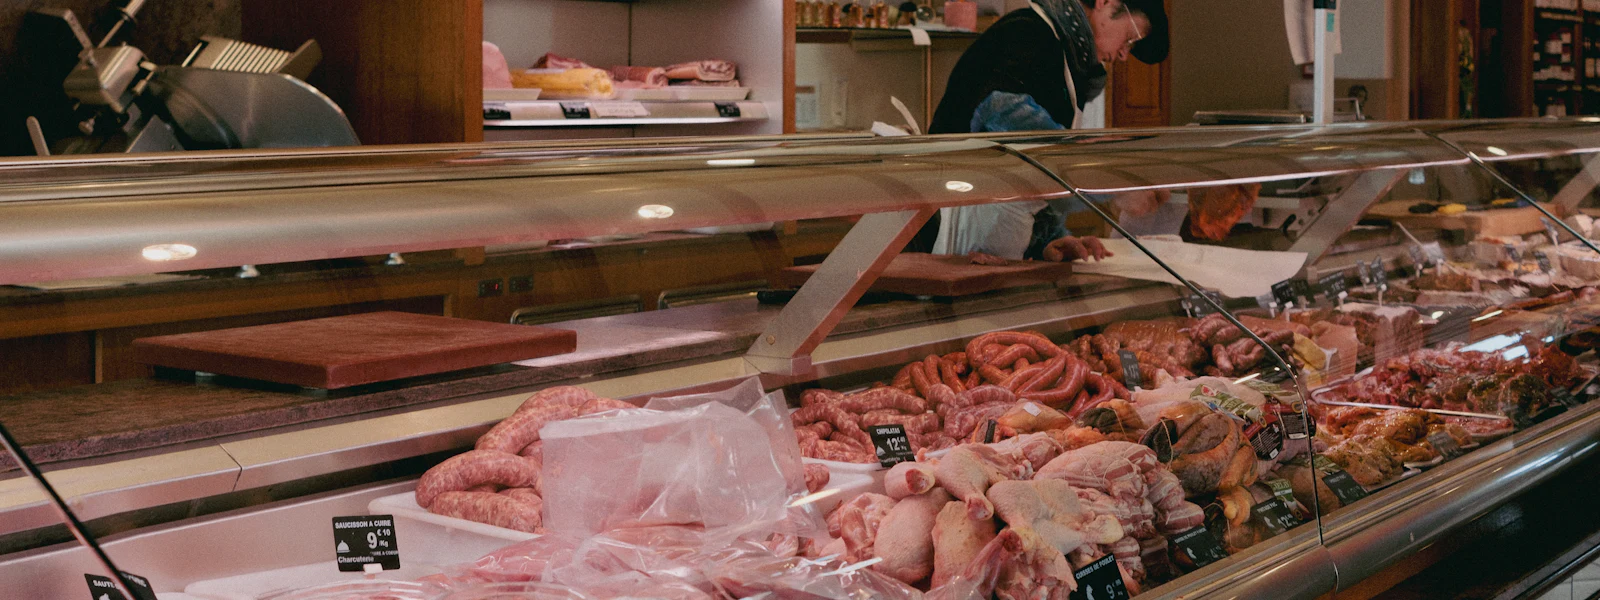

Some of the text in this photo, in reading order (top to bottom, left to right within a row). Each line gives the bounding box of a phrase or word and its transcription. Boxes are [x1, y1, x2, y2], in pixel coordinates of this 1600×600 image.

[886, 437, 901, 451] 12
[335, 521, 368, 529] SAUCISSON
[373, 519, 392, 527] CUIRE
[1277, 516, 1293, 529] 12
[366, 531, 378, 549] 9
[337, 556, 375, 564] Charcuterie
[1075, 566, 1094, 580] CUISSES
[1098, 554, 1115, 568] POULET
[1105, 584, 1115, 600] 9
